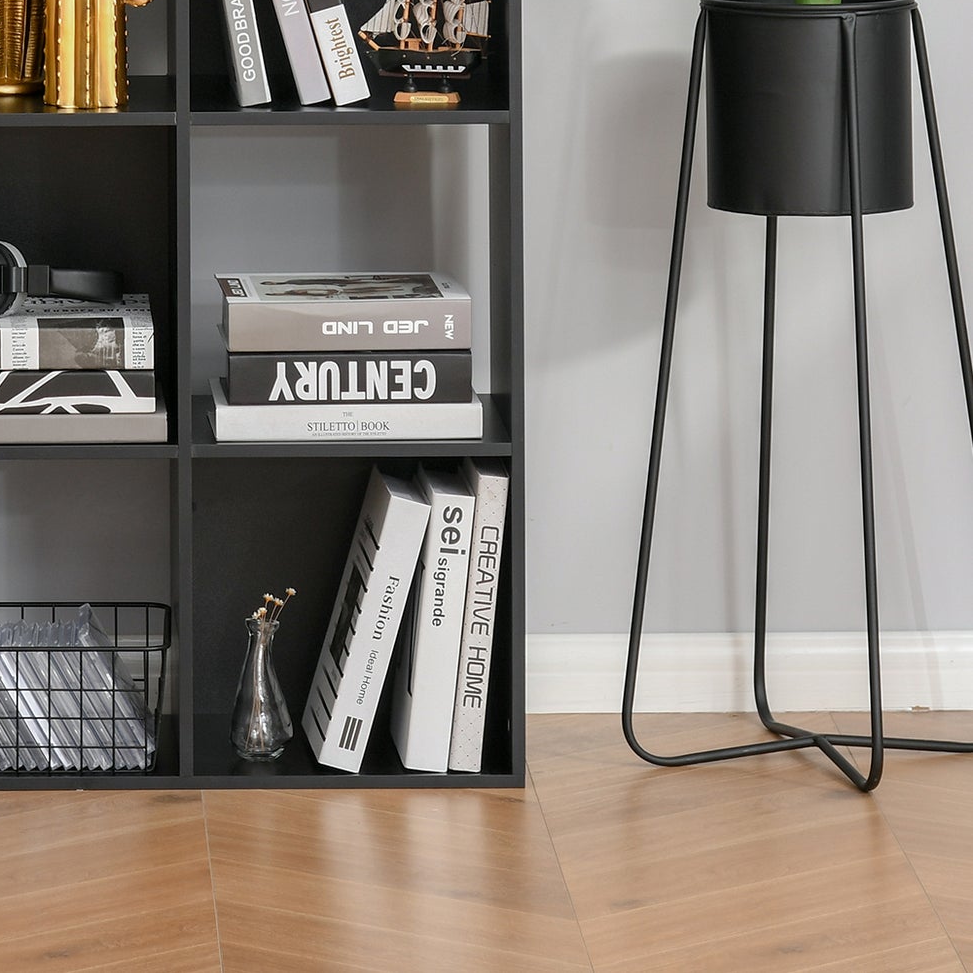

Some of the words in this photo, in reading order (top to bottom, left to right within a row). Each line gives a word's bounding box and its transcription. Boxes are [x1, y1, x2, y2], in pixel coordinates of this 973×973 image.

[237, 32, 256, 81] GOOD
[325, 17, 356, 81] Brightest
[322, 321, 373, 335] LIND
[383, 320, 429, 334] JED
[444, 314, 454, 340] NEW
[268, 360, 436, 401] CENTURY
[307, 421, 356, 431] STILETTO
[361, 421, 390, 431] BOOK
[440, 506, 466, 555] sei
[432, 557, 450, 626] sigrande
[471, 526, 499, 636] CREATIVE
[372, 576, 400, 640] Fashion
[365, 649, 379, 674] Ideal
[463, 646, 487, 708] HOME
[357, 676, 372, 705] Home
